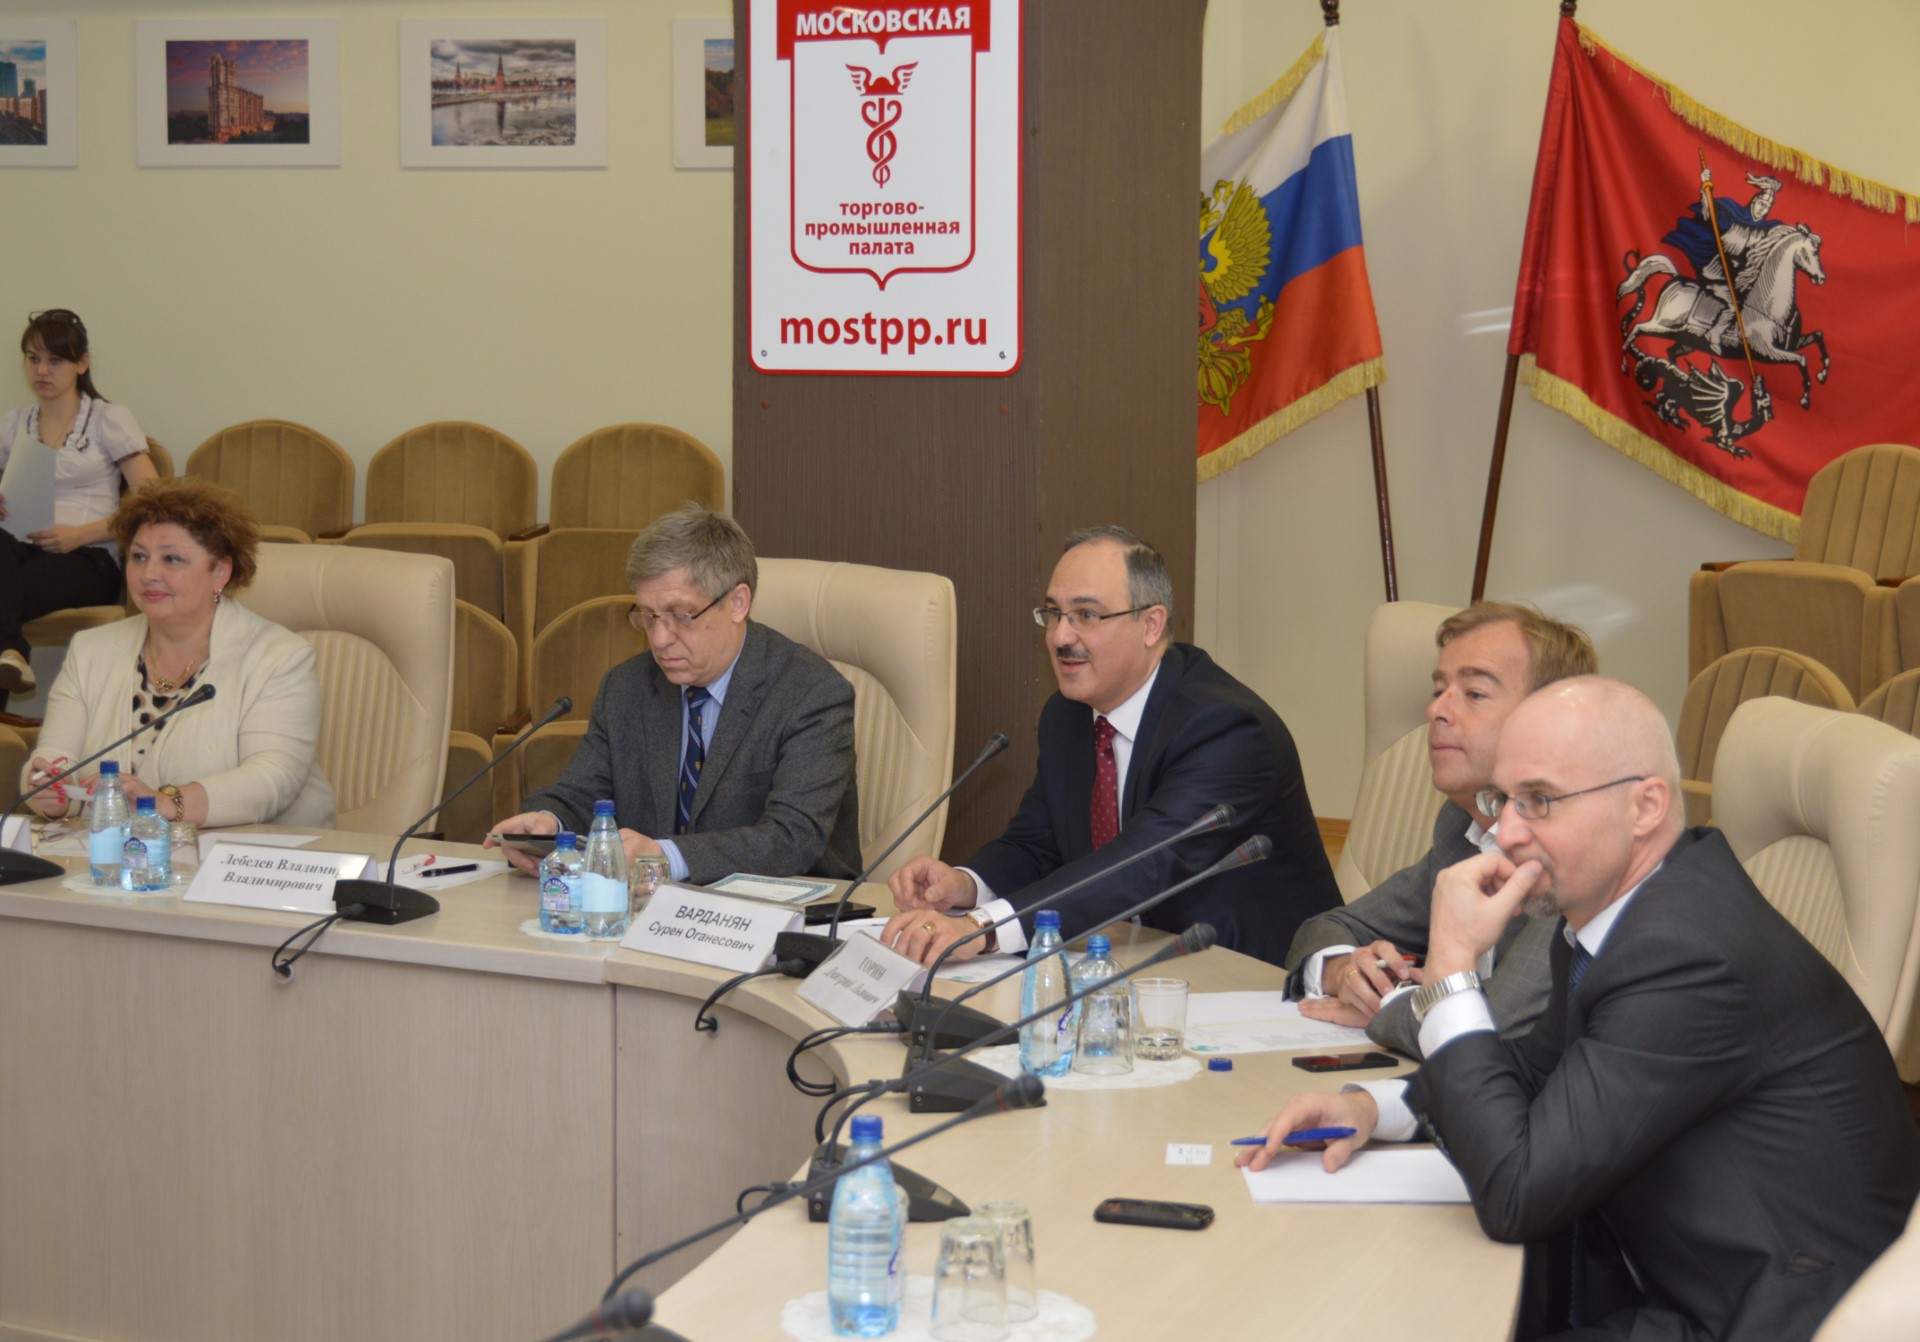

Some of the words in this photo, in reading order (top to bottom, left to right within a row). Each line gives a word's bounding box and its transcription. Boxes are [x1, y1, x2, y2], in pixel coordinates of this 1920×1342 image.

[796, 7, 971, 36] МОСКОВСКАЯ
[839, 201, 925, 220] торгово-
[805, 221, 960, 240] промышленная
[849, 240, 915, 255] палата
[780, 311, 987, 355] mostpp.ru
[220, 853, 274, 870] Лебедев
[223, 871, 323, 891] Владимирович
[675, 905, 752, 932] ВАРДАНЯН
[648, 921, 684, 936] Сурен
[685, 927, 755, 952] Оганесович
